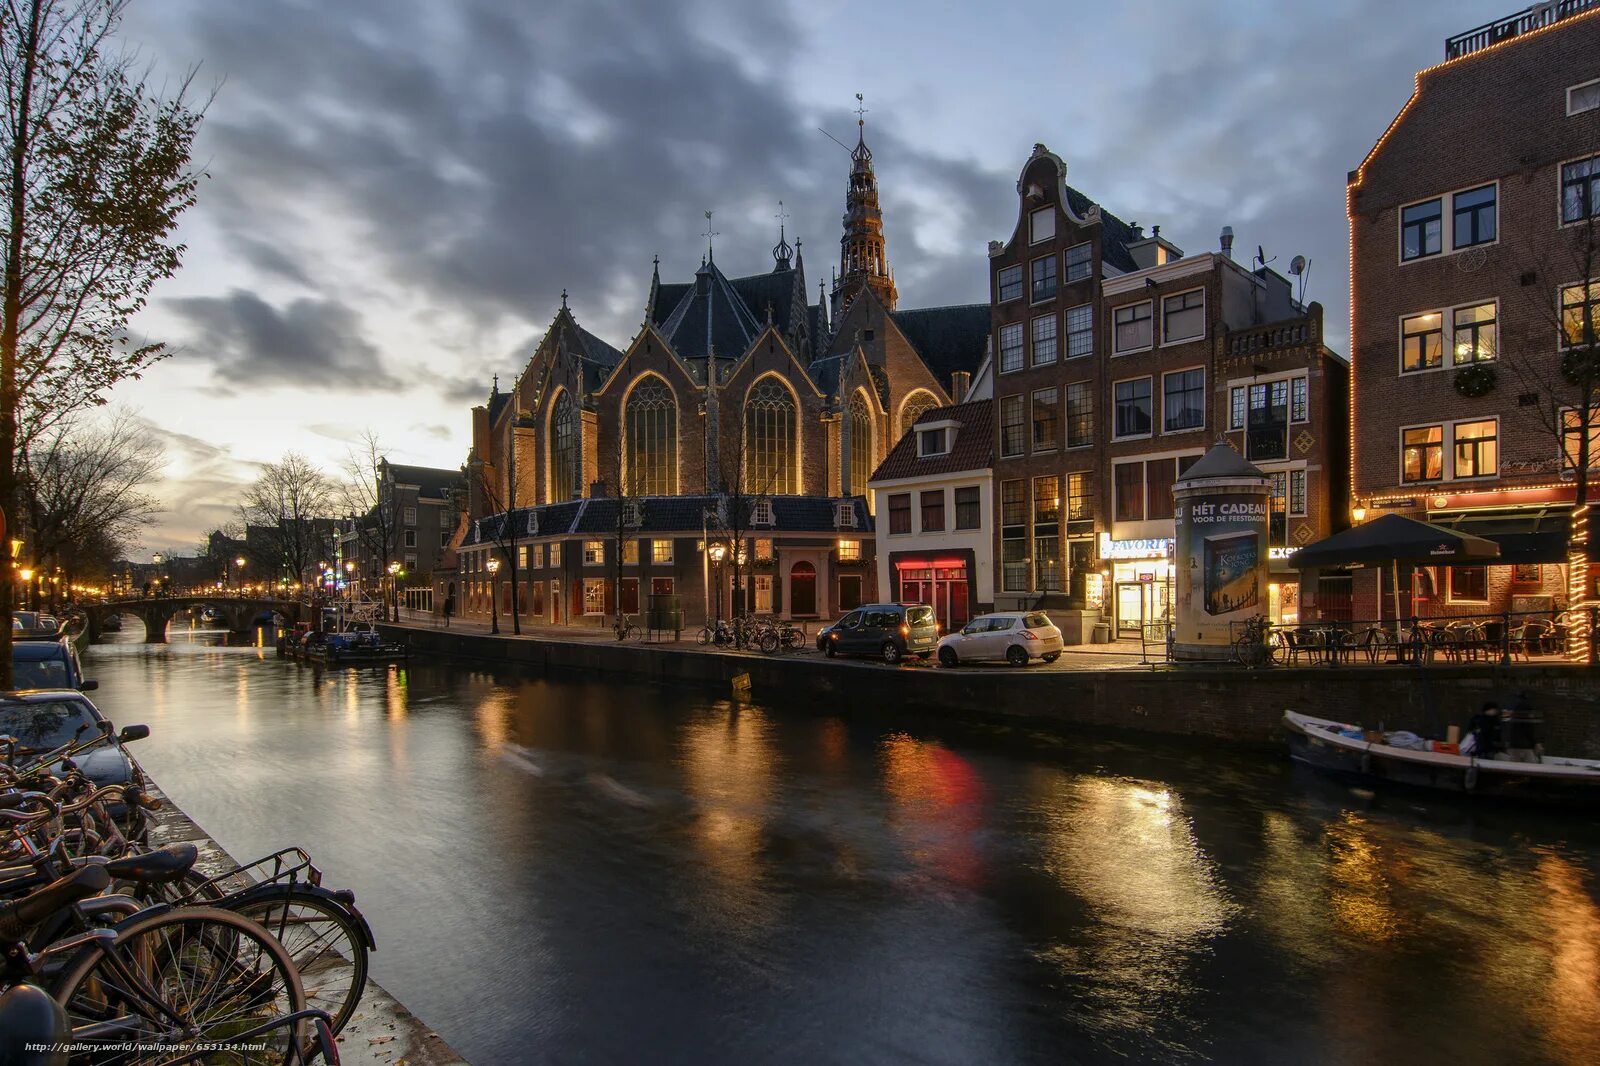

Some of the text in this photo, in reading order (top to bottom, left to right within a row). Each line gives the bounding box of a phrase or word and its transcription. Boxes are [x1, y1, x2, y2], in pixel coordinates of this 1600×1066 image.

[1192, 501, 1266, 516] HÉT CADEAU
[1192, 516, 1214, 524] VOOR
[1228, 515, 1266, 523] FEESTDAGEN
